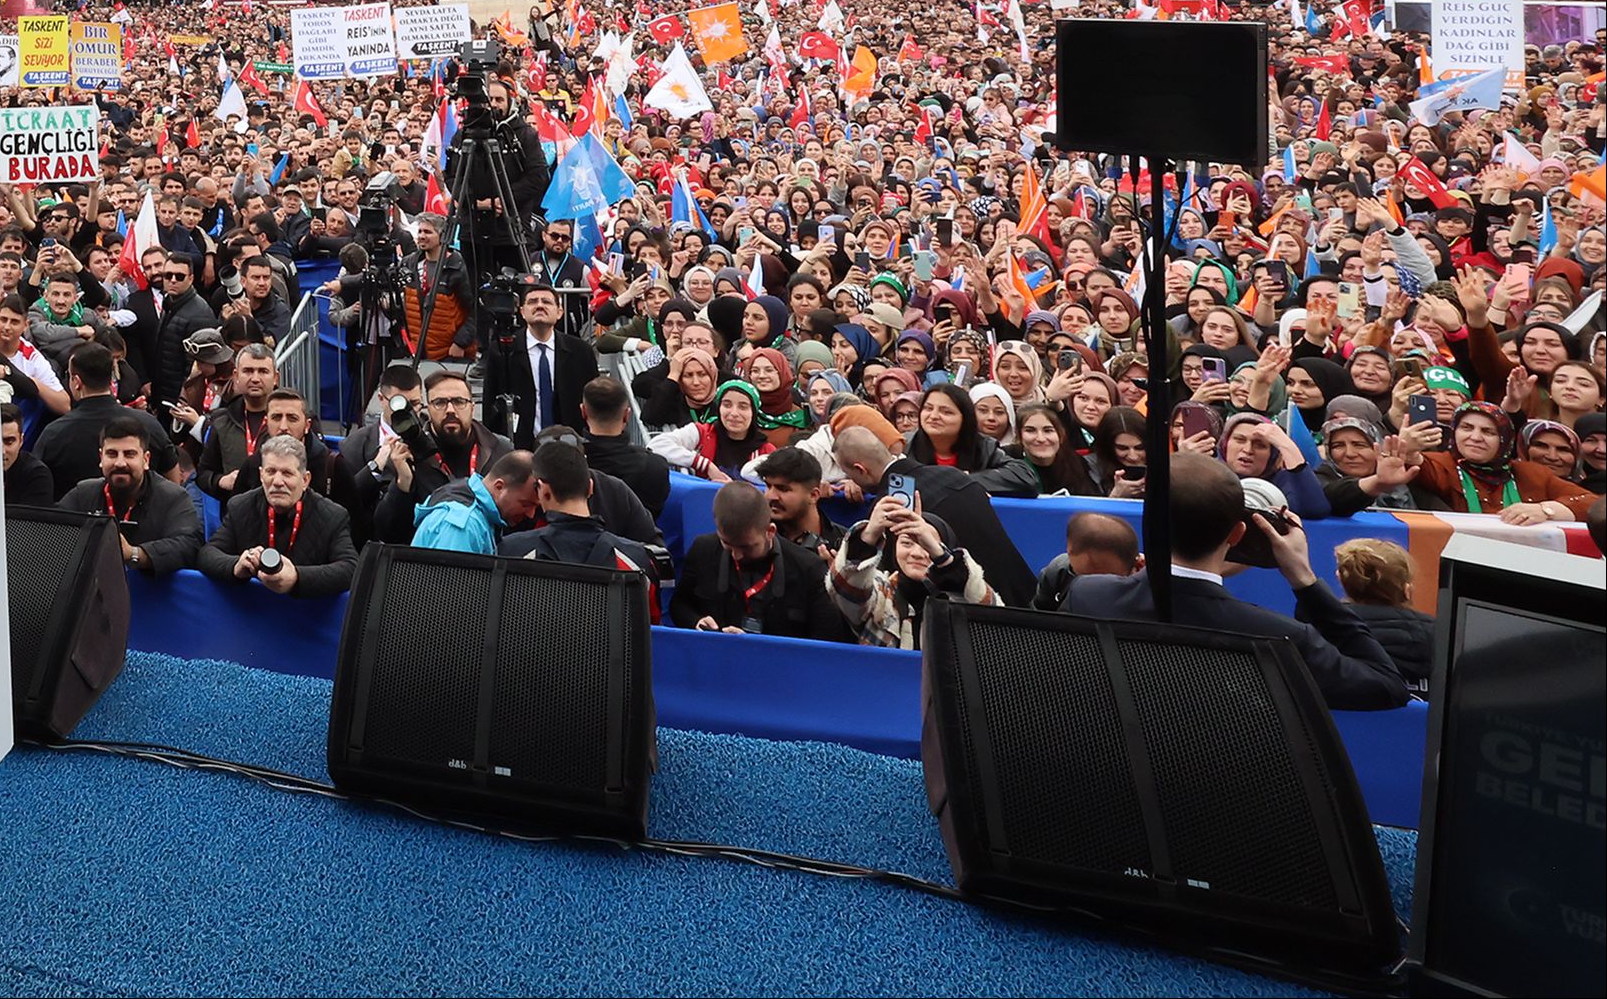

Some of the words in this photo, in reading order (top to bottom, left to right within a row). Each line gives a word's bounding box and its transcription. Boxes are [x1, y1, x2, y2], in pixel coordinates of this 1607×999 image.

[399, 17, 439, 26] OLMAKTA
[401, 33, 441, 42] OLMAKLA
[1439, 29, 1516, 38] KADINLAR
[347, 42, 391, 57] YANINDA
[9, 154, 96, 181] BURADA
[448, 758, 467, 770] d&b
